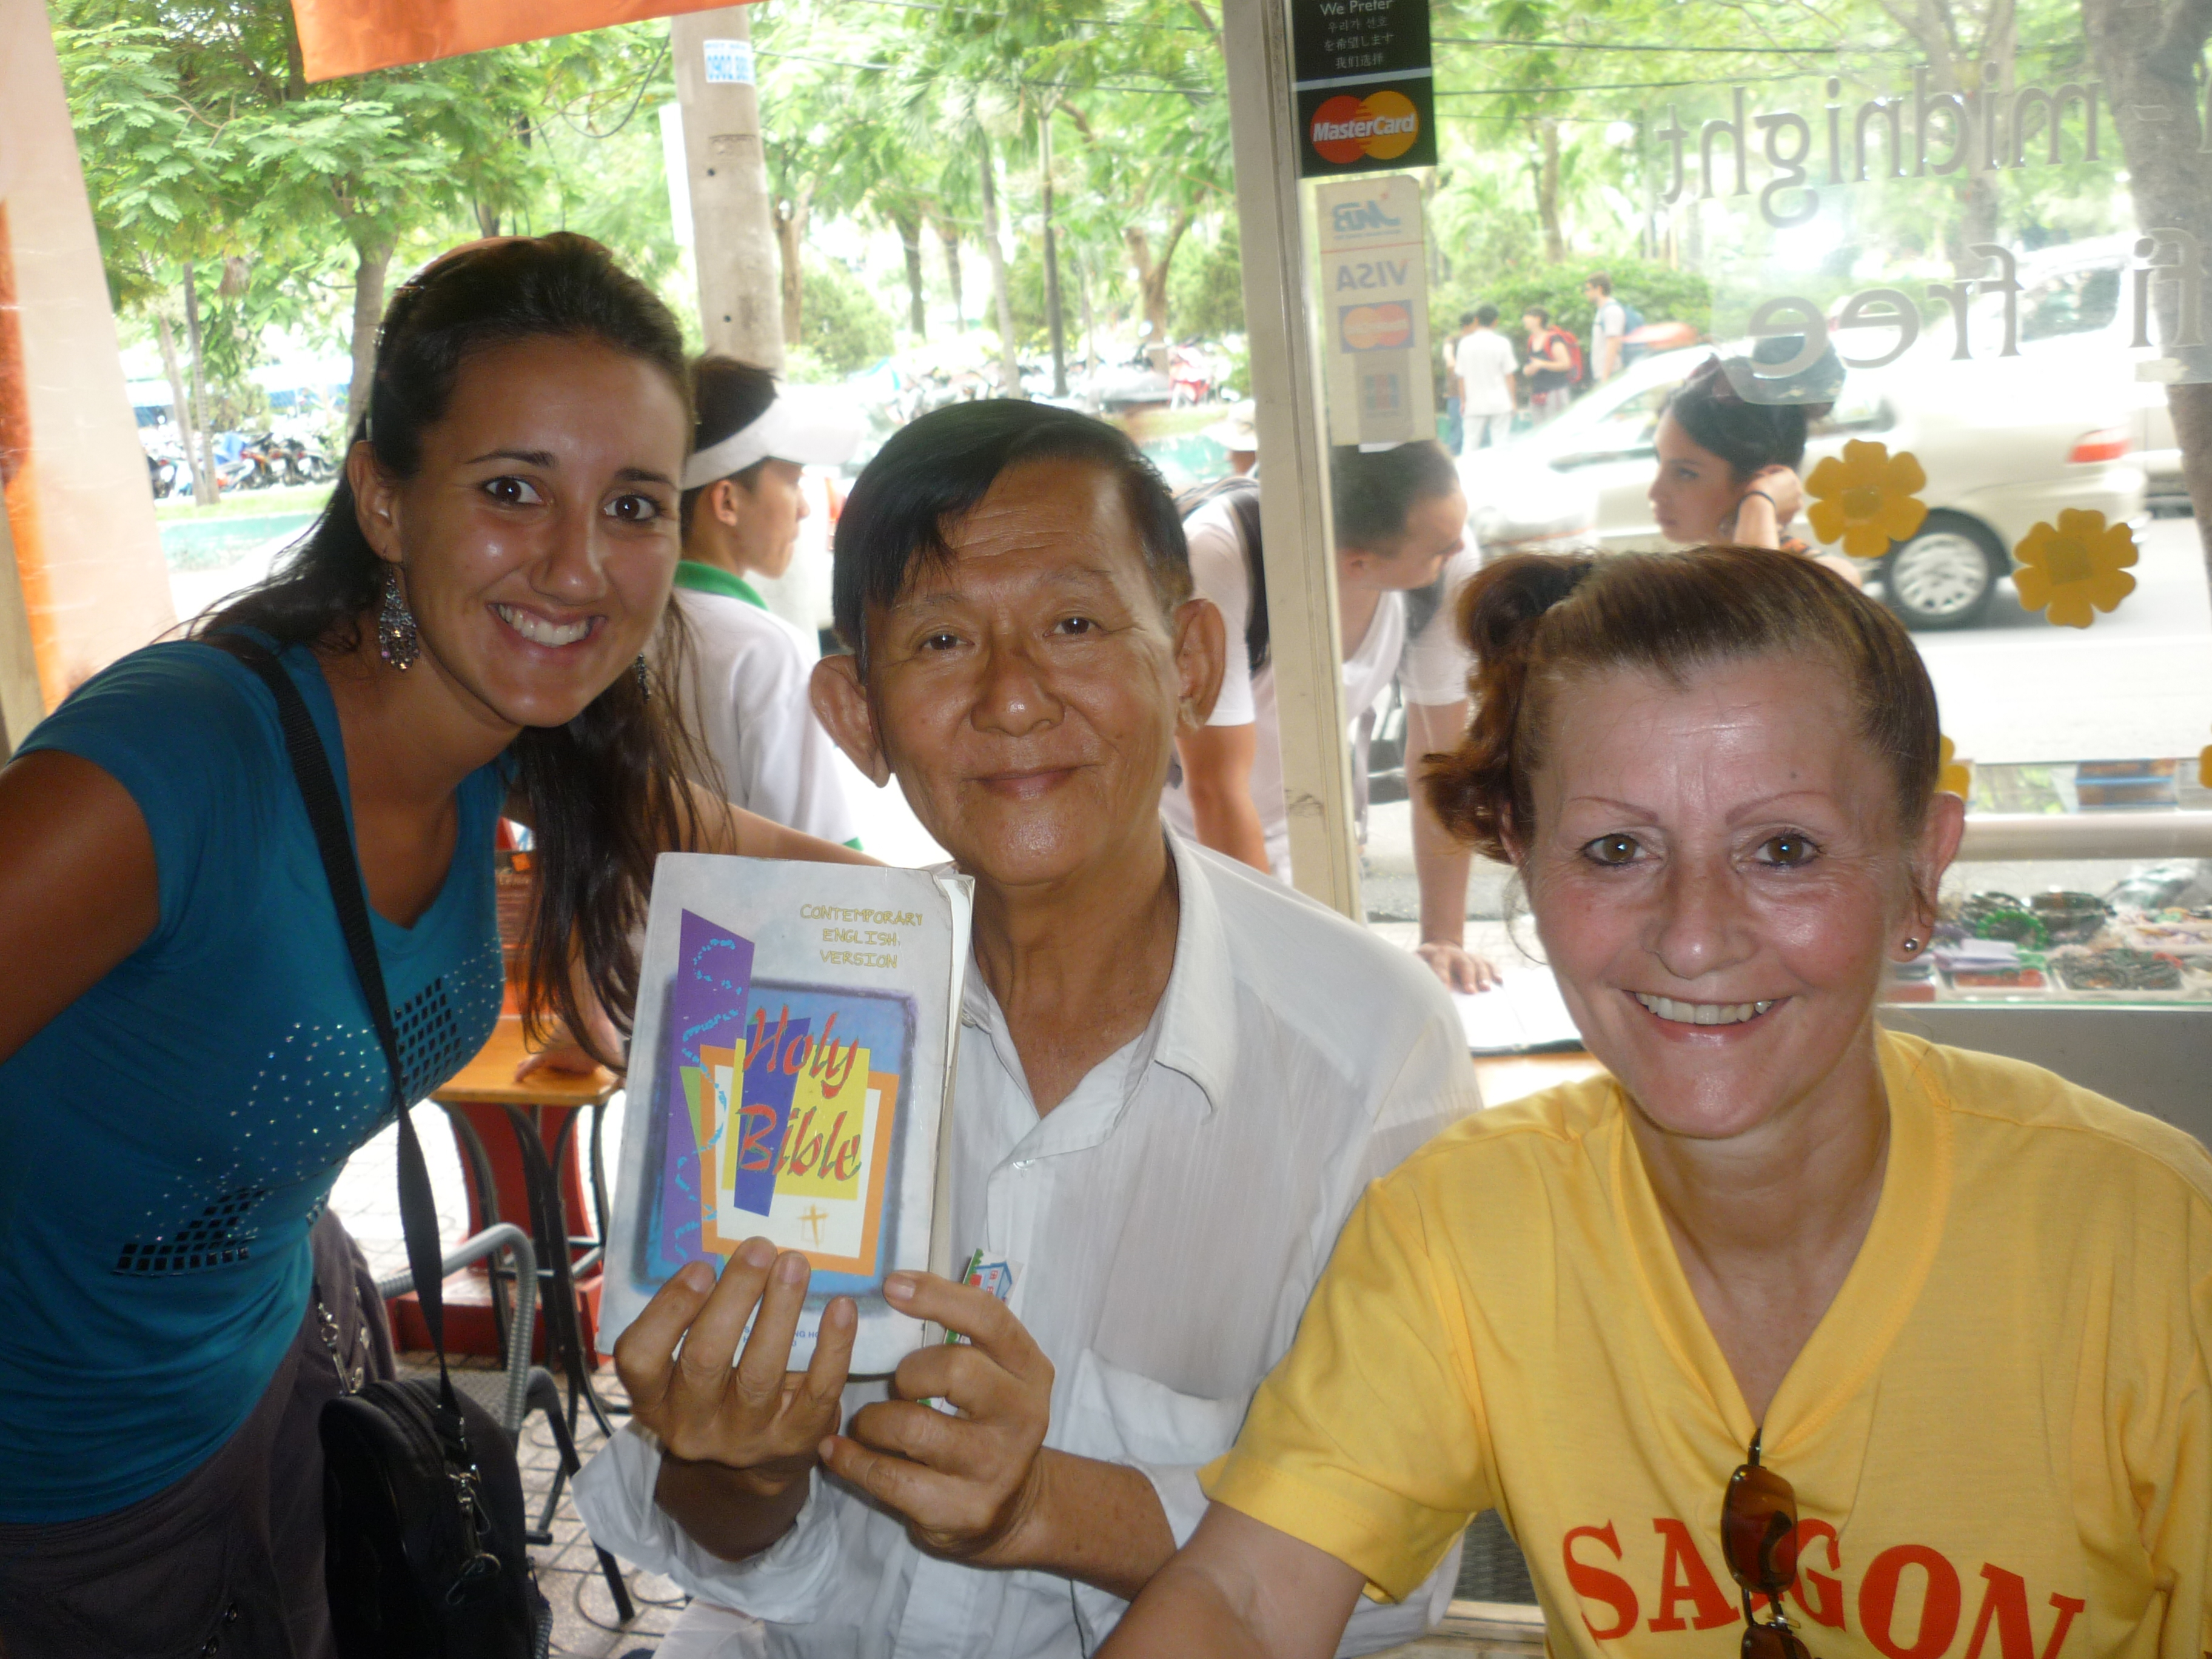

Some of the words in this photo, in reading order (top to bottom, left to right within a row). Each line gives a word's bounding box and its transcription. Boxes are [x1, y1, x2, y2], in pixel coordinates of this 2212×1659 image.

[1319, 2, 1344, 16] We
[1350, 0, 1395, 13] Prefer
[1313, 113, 1415, 142] MasterCard
[800, 903, 923, 927] CONTEMPORARY
[823, 928, 897, 946] ENGLISH
[820, 950, 897, 968] VERSION
[742, 1003, 859, 1099] Holy
[736, 1104, 862, 1181] Bible
[1562, 1517, 2086, 1659] SAGON
